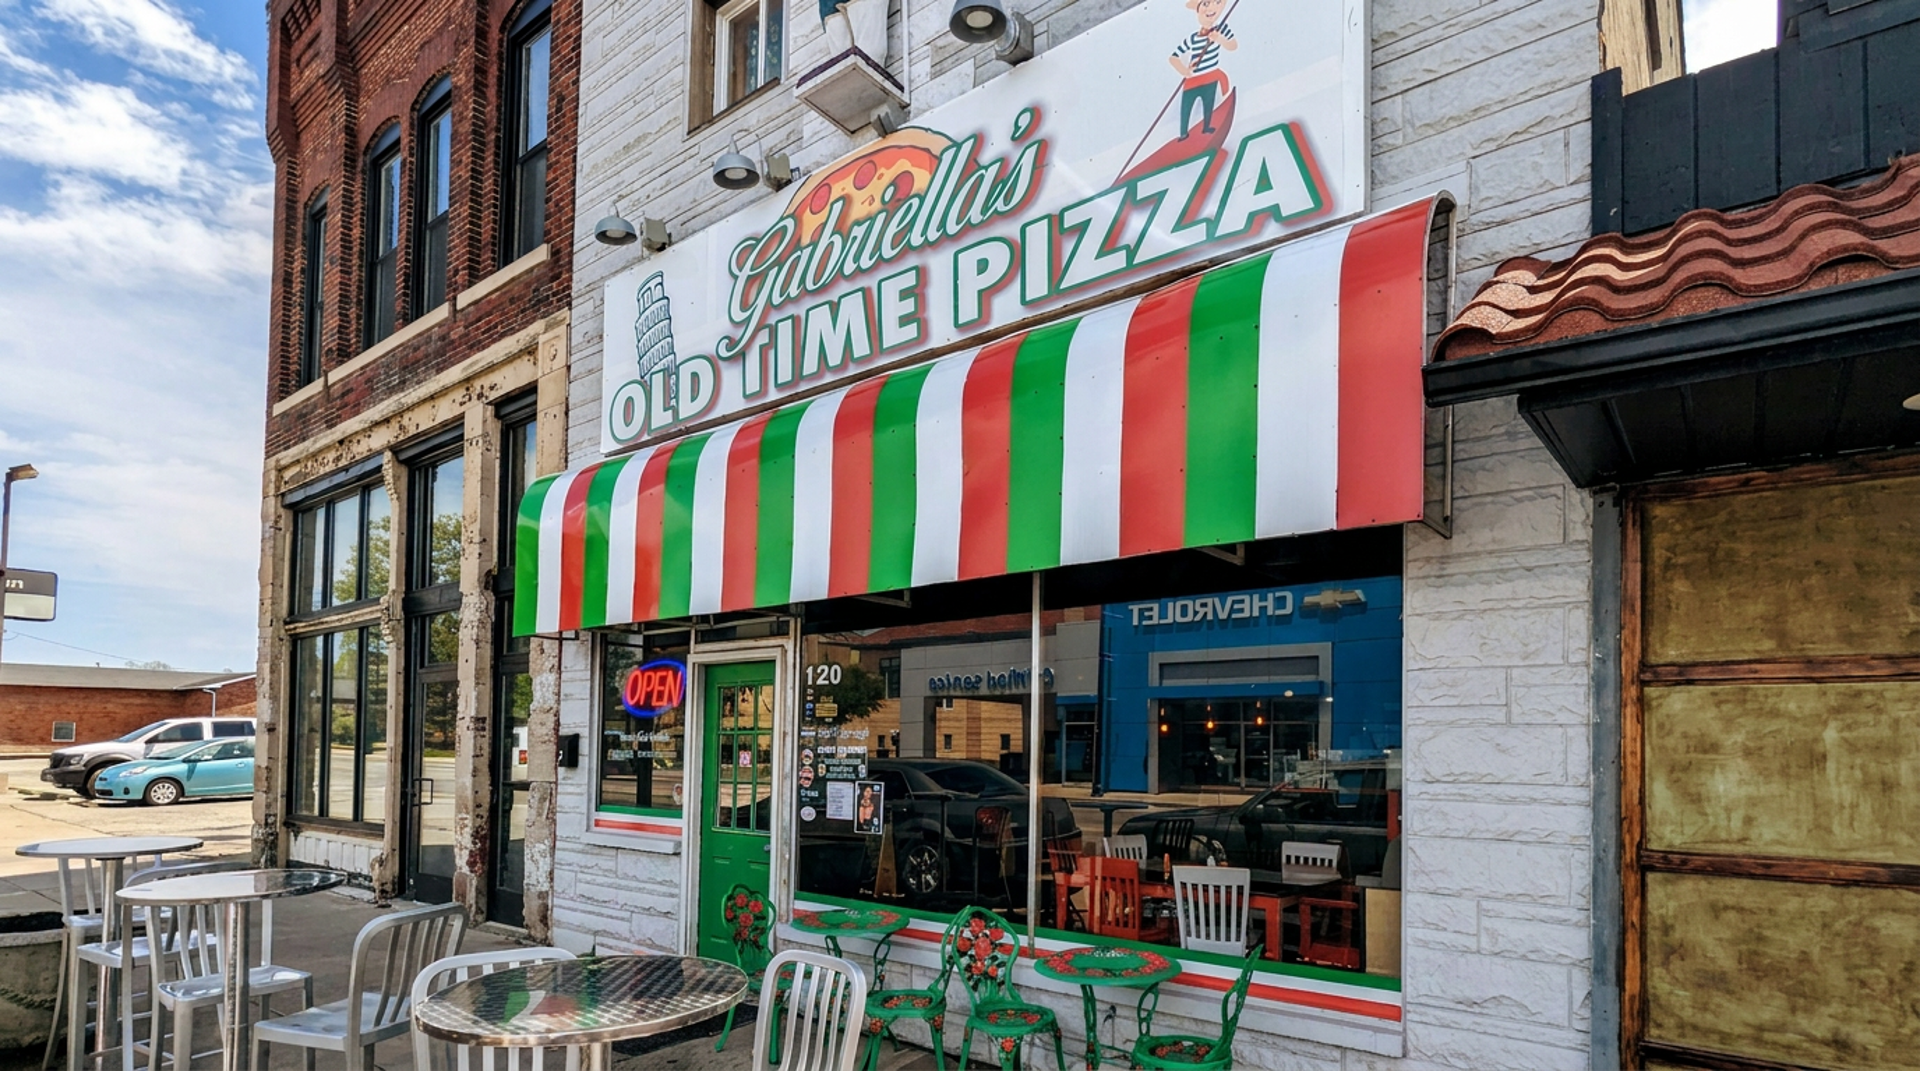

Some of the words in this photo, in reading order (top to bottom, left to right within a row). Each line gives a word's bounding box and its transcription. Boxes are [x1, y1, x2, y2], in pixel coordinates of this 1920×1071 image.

[610, 354, 717, 443] OLD
[742, 266, 921, 399] TIME
[953, 122, 1325, 328] PIZZA
[716, 107, 1044, 360] Gabriella's
[626, 670, 682, 707] OPEN
[806, 664, 842, 685] 120
